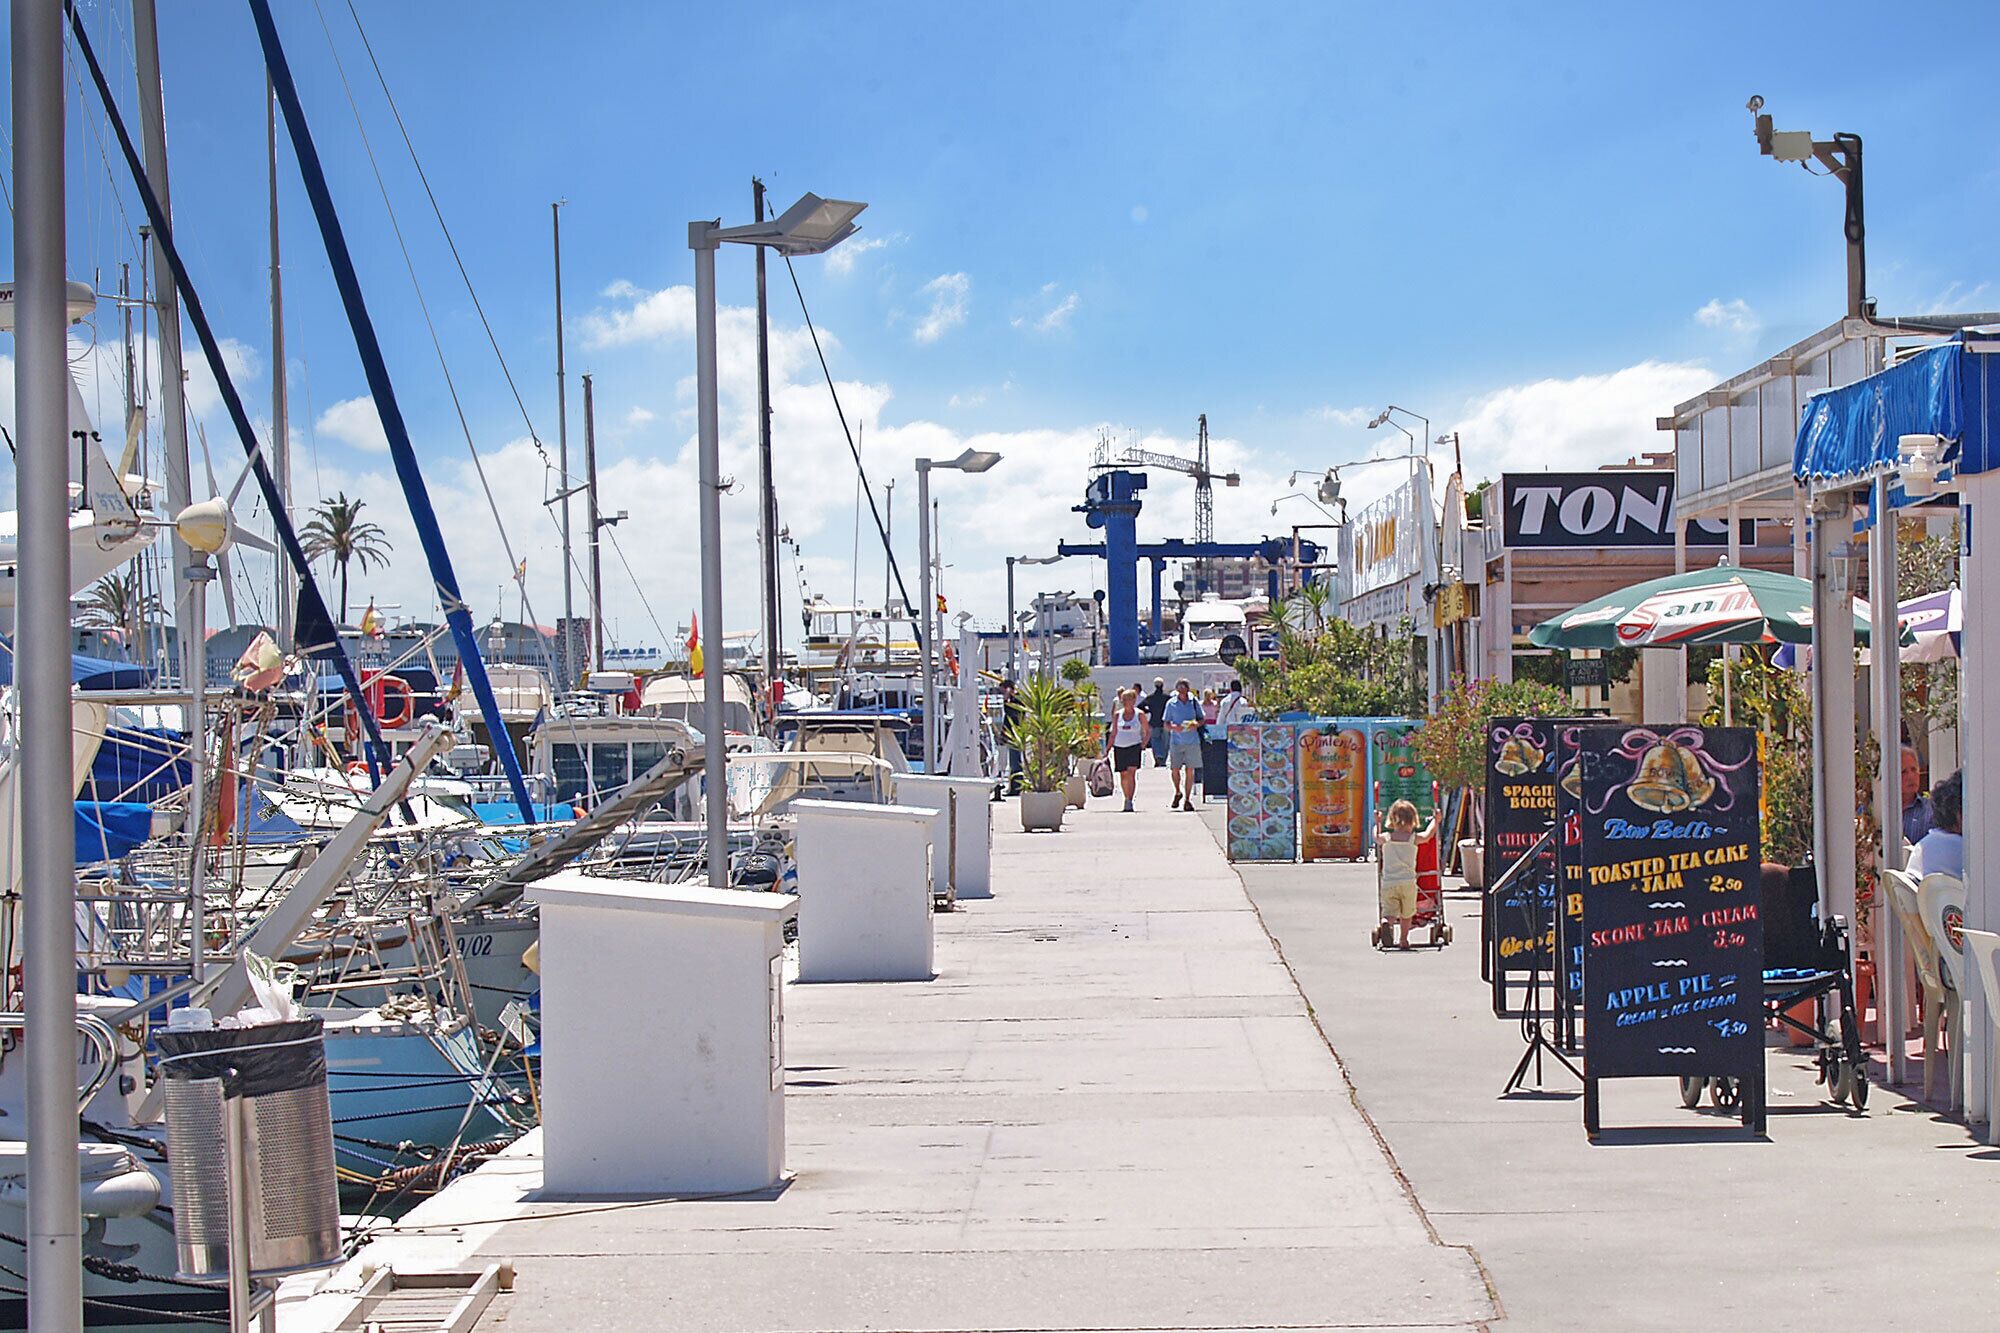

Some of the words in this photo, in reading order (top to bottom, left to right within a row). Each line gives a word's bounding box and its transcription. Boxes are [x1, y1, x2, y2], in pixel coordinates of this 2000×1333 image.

[1603, 818, 1650, 840] Bow
[1650, 818, 1714, 840] Bells
[1588, 857, 1666, 886] TOASTED
[1669, 851, 1702, 870] TEA
[1704, 844, 1749, 866] CAKE
[1640, 872, 1684, 894] JAM
[1591, 922, 1646, 948] SCONE
[1653, 915, 1690, 938] JAM
[1702, 903, 1758, 928] CREAM
[1606, 981, 1672, 1011] APPLE
[1678, 974, 1714, 996] PIE
[1615, 1009, 1657, 1028] CREAM
[1670, 1001, 1690, 1016] ICE
[1692, 993, 1737, 1012] CREAM
